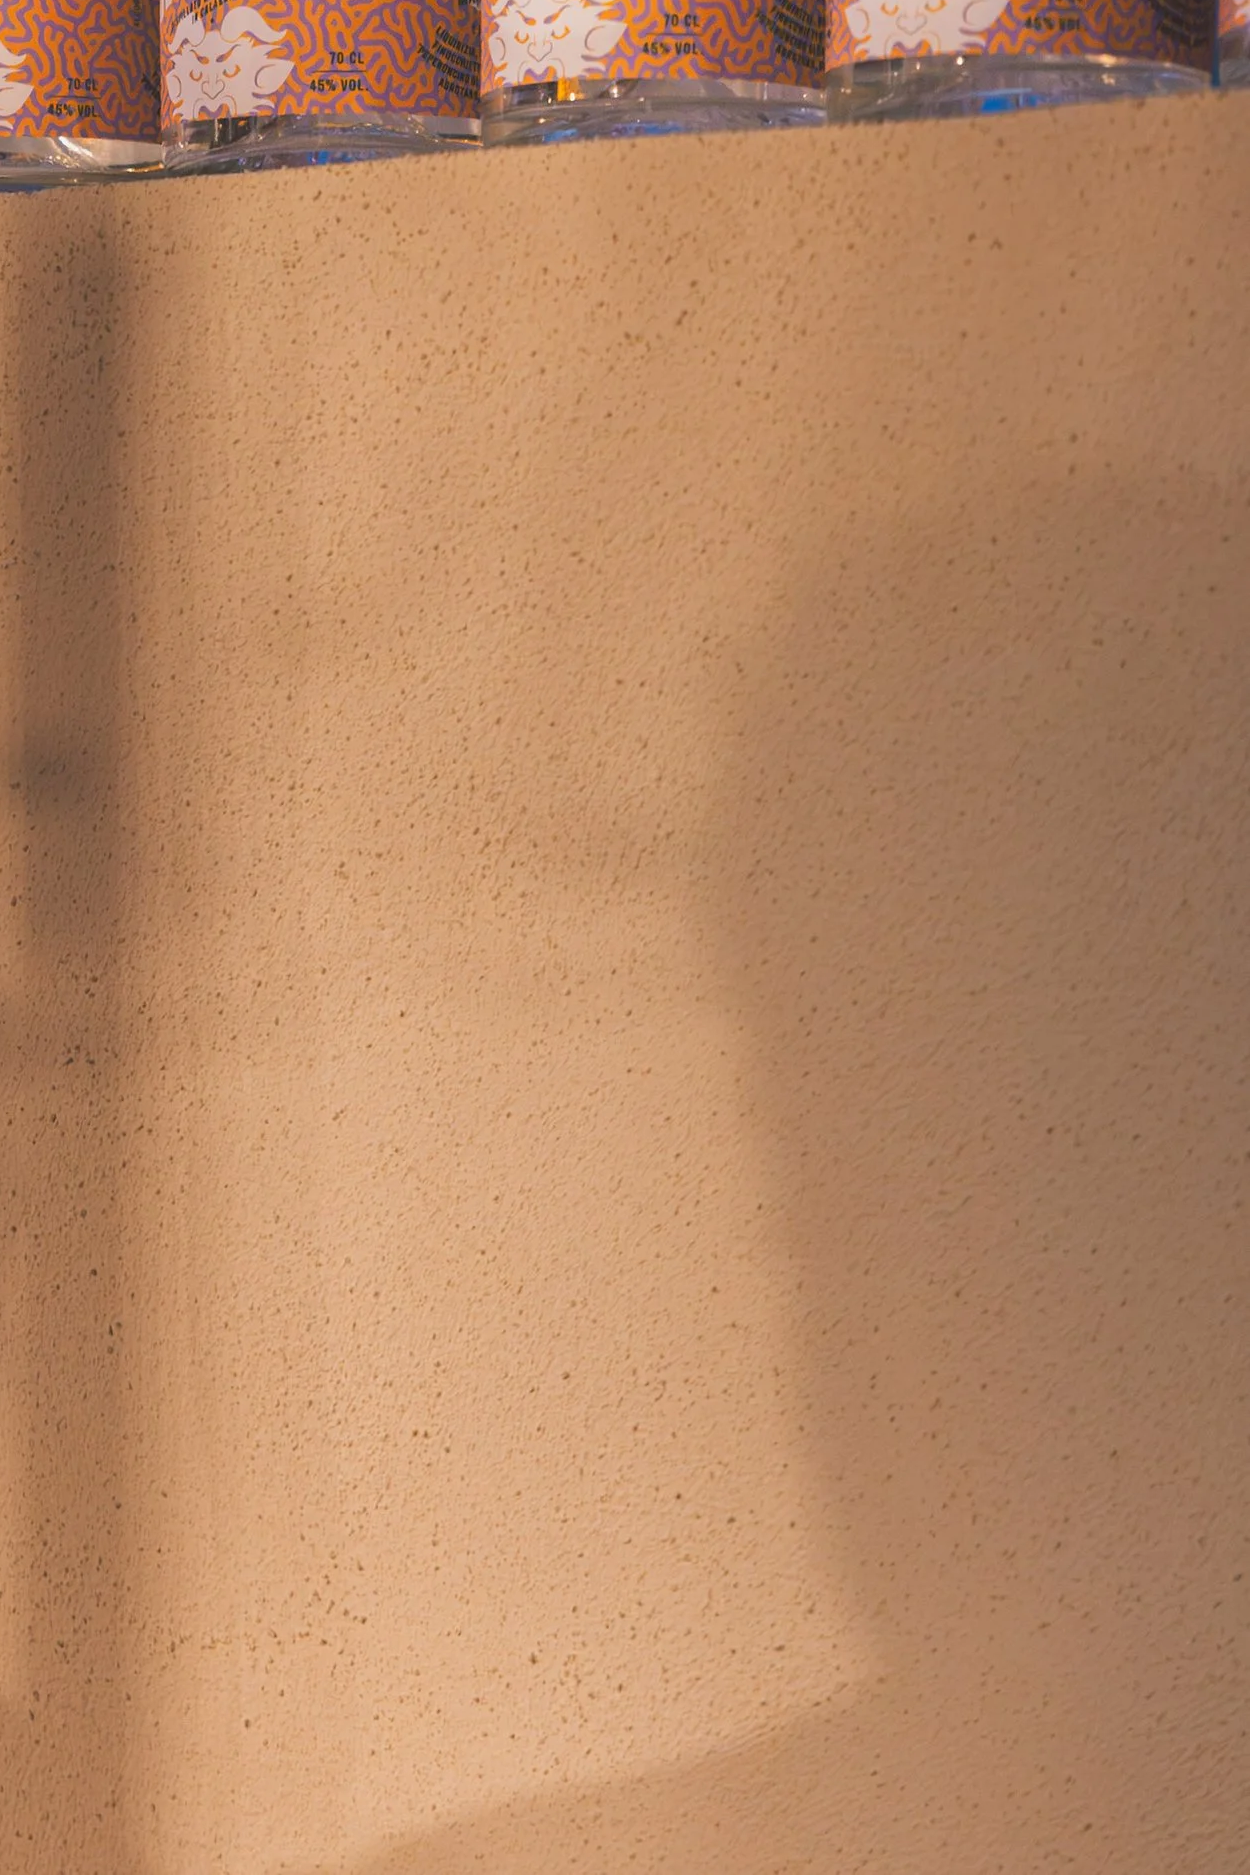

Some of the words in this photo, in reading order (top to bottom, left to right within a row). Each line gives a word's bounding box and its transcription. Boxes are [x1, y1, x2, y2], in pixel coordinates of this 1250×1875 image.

[664, 13, 679, 27] 70
[684, 13, 699, 28] CL
[642, 41, 669, 56] 45%
[329, 51, 344, 66] 70
[349, 51, 365, 66] CL
[67, 78, 81, 92] 70
[84, 78, 99, 92] CL
[309, 78, 336, 93] 45%
[47, 103, 74, 118] 45%
